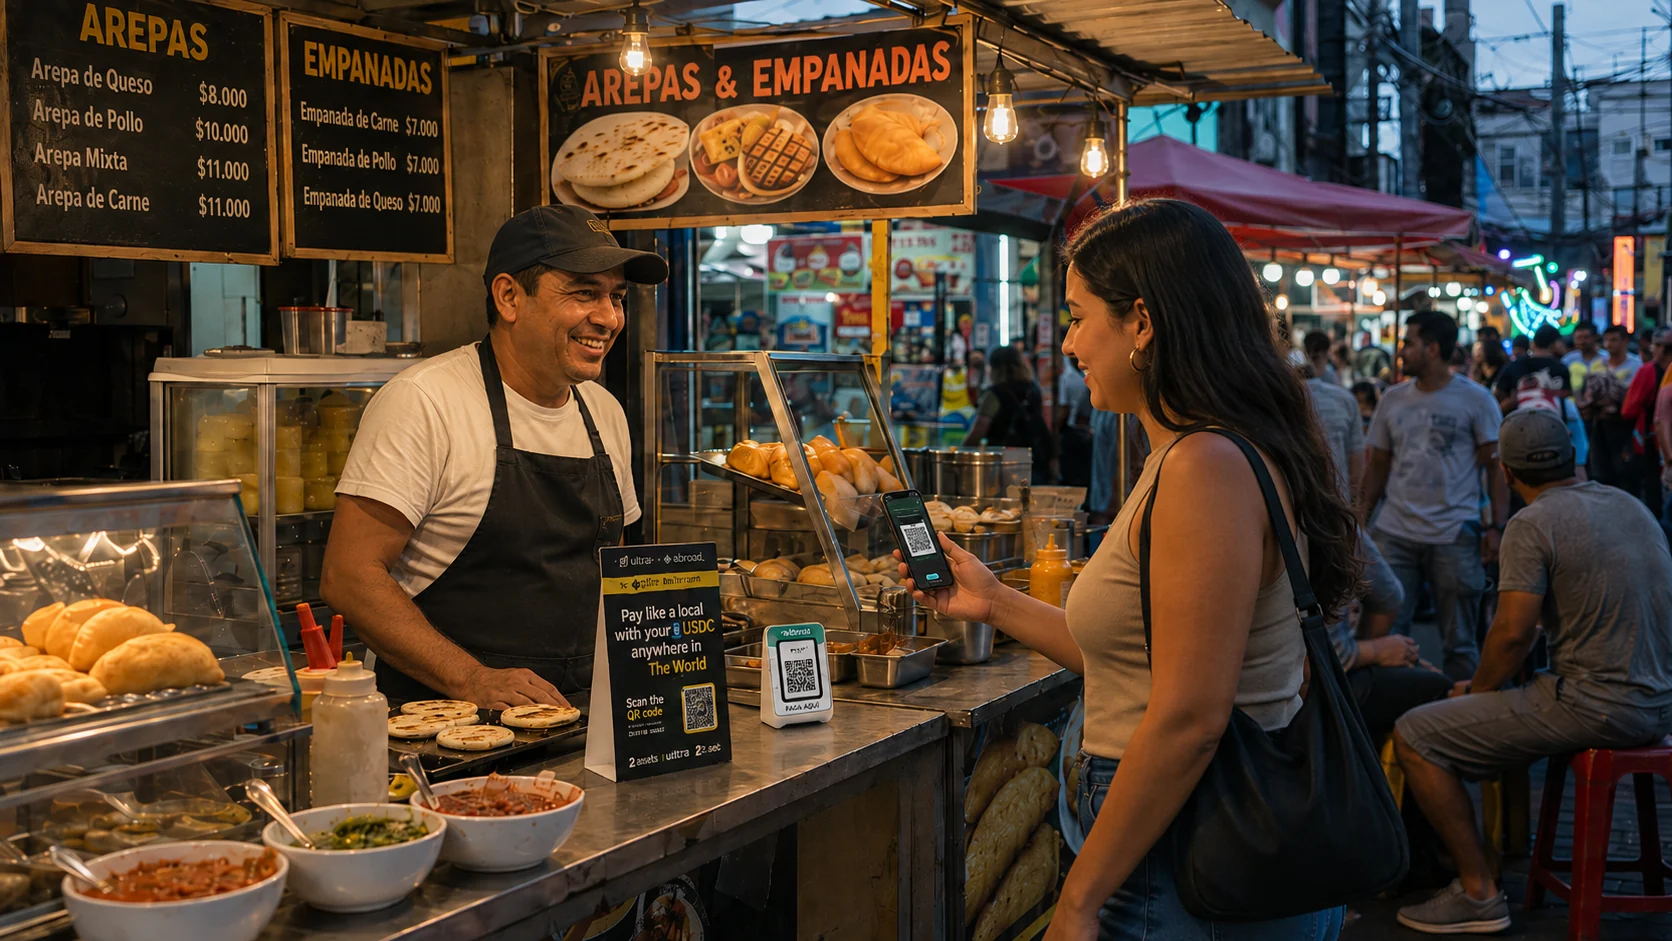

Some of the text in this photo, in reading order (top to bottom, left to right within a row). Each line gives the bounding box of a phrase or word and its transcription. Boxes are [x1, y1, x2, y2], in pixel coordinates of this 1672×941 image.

[80, 3, 209, 61] AREPAS
[31, 57, 247, 108] Arepa de Queso $8.000
[304, 40, 432, 95] EMPANADAS
[581, 40, 951, 108] AREPAS & EMPANADAS
[33, 99, 249, 144] Arepa de Pollo $10.000
[300, 101, 438, 138] Empanada de Carne $7.000
[34, 143, 249, 181] Arepa Mixta $11.000
[302, 143, 439, 175] Empanada de Pollo $7.000
[36, 184, 250, 218] Arepa de Carne $11.000
[303, 186, 440, 213] Empanada de Queso $7.000
[621, 602, 704, 625] Pay like a local
[615, 619, 715, 642] with your USDC
[631, 639, 702, 660] anywhere in
[649, 656, 707, 676] The World
[626, 694, 664, 708] Scan the
[627, 706, 663, 721] QR code
[629, 757, 636, 768] 2
